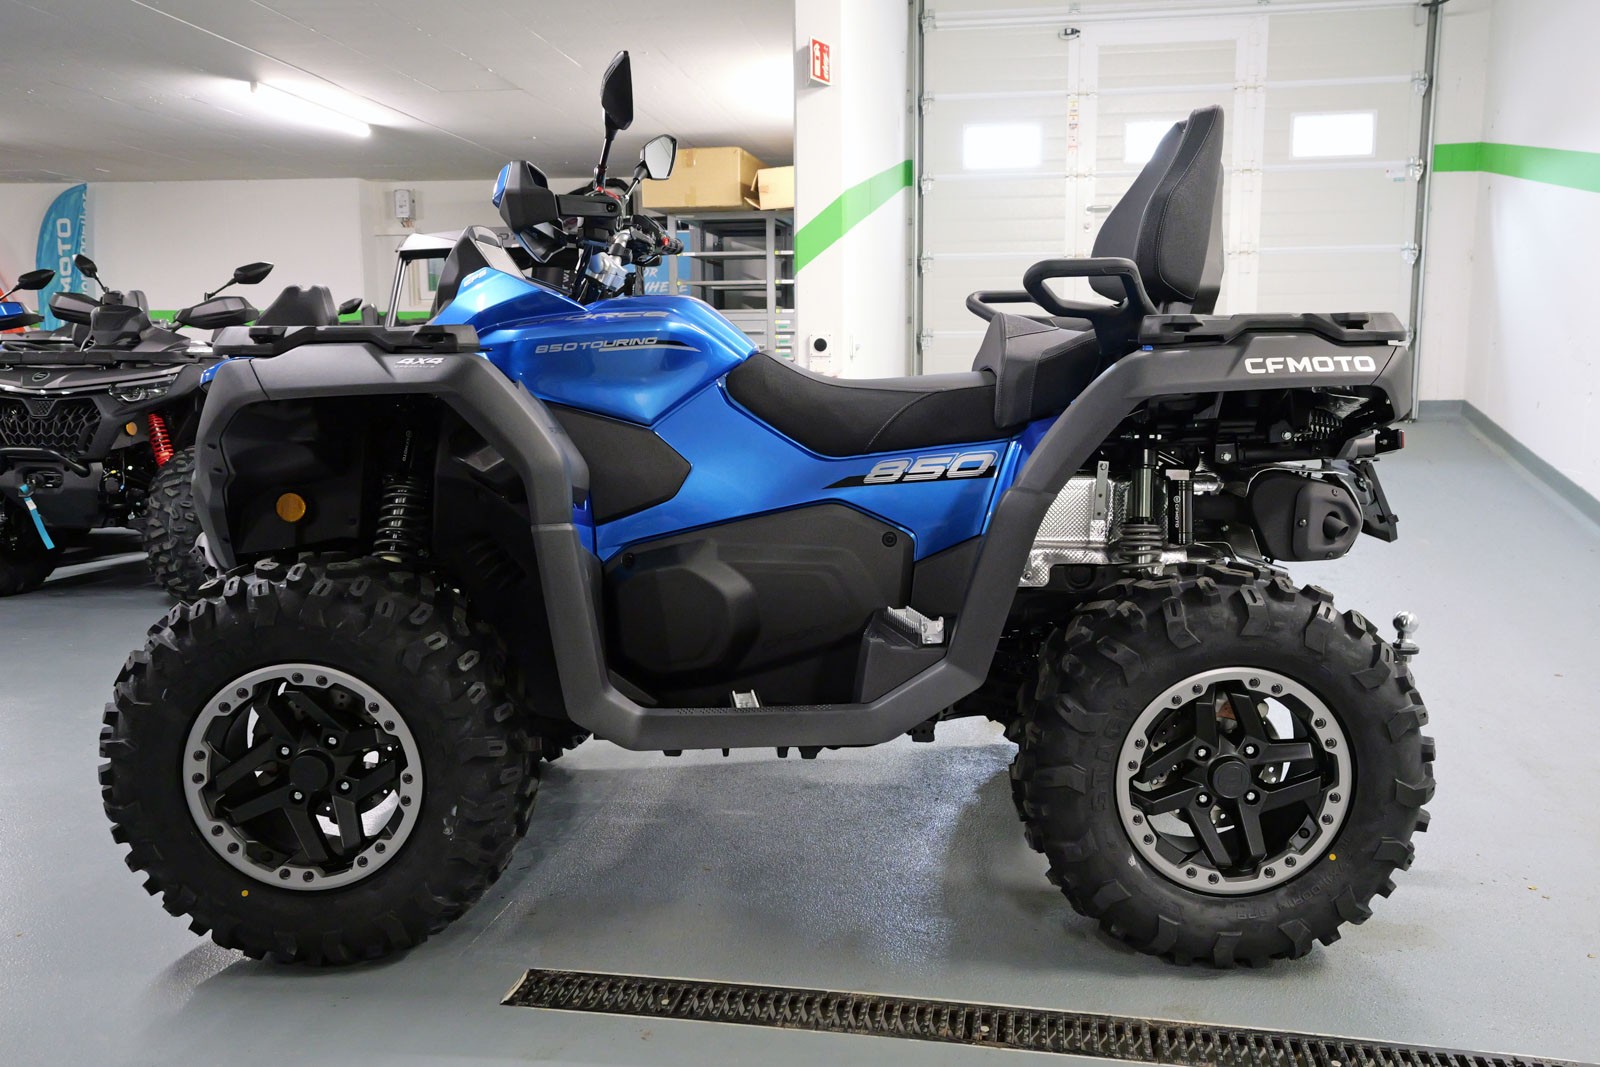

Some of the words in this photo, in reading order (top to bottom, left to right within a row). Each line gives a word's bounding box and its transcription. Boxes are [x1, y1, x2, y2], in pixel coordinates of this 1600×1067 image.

[57, 218, 72, 293] MOTO
[1245, 355, 1376, 374] CFMOTO
[863, 450, 998, 484] 850
